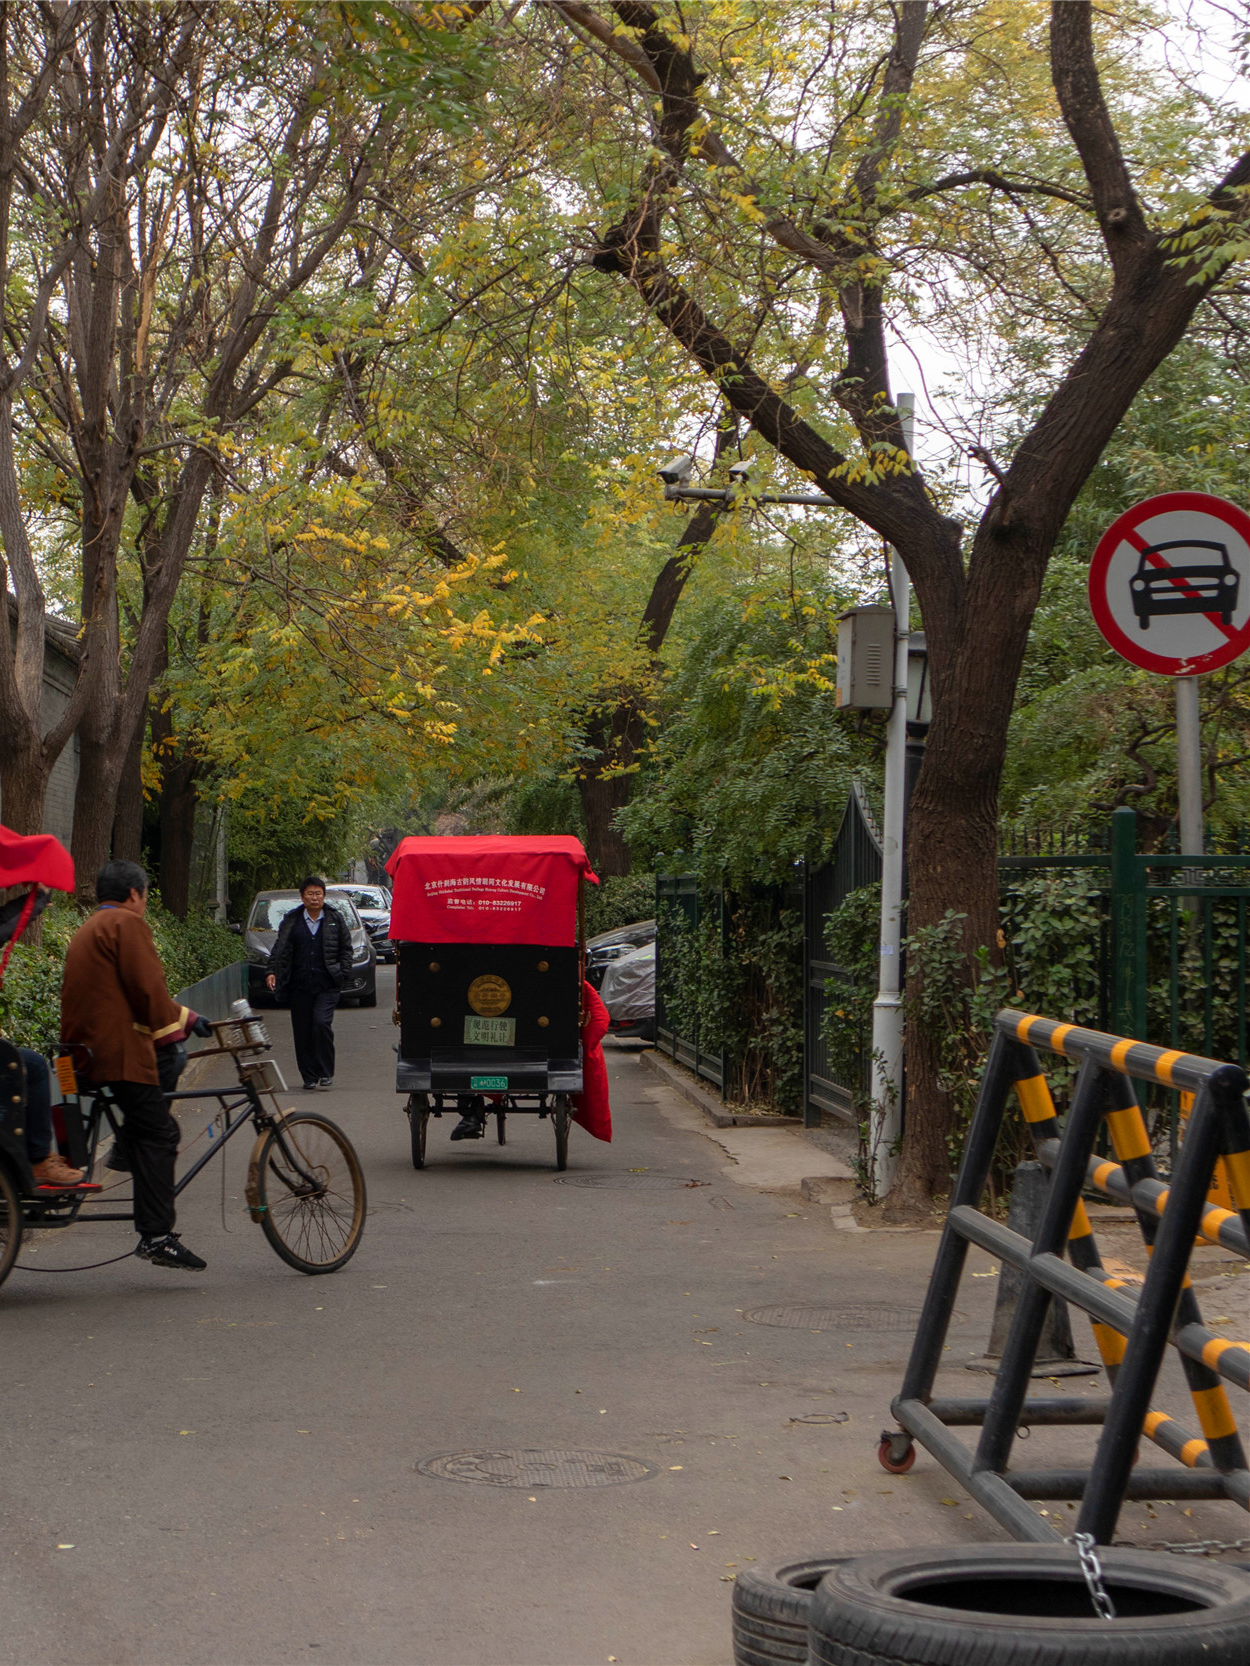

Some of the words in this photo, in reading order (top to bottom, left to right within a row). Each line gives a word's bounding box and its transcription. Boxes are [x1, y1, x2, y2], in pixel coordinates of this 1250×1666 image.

[473, 1019, 507, 1031] 规范行驶
[473, 1031, 507, 1043] 文明礼让
